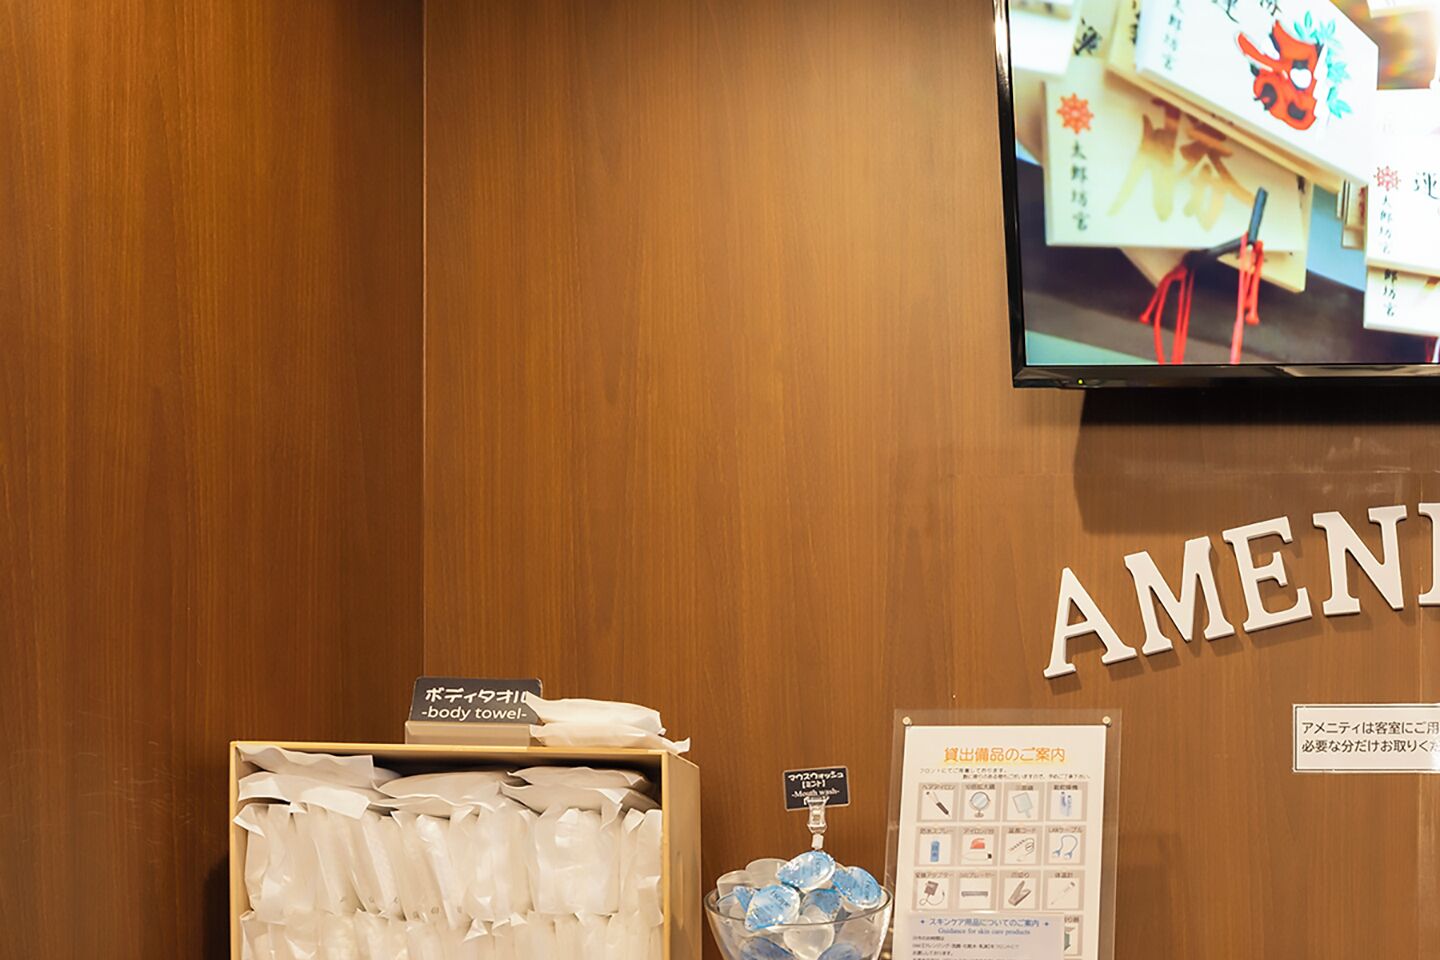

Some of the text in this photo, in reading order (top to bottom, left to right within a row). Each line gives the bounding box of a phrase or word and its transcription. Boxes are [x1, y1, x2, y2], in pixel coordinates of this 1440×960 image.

[424, 686, 528, 704] ボディタオル
[421, 705, 528, 721] -body towel-
[944, 746, 1065, 763] 貸出備品のご案内
